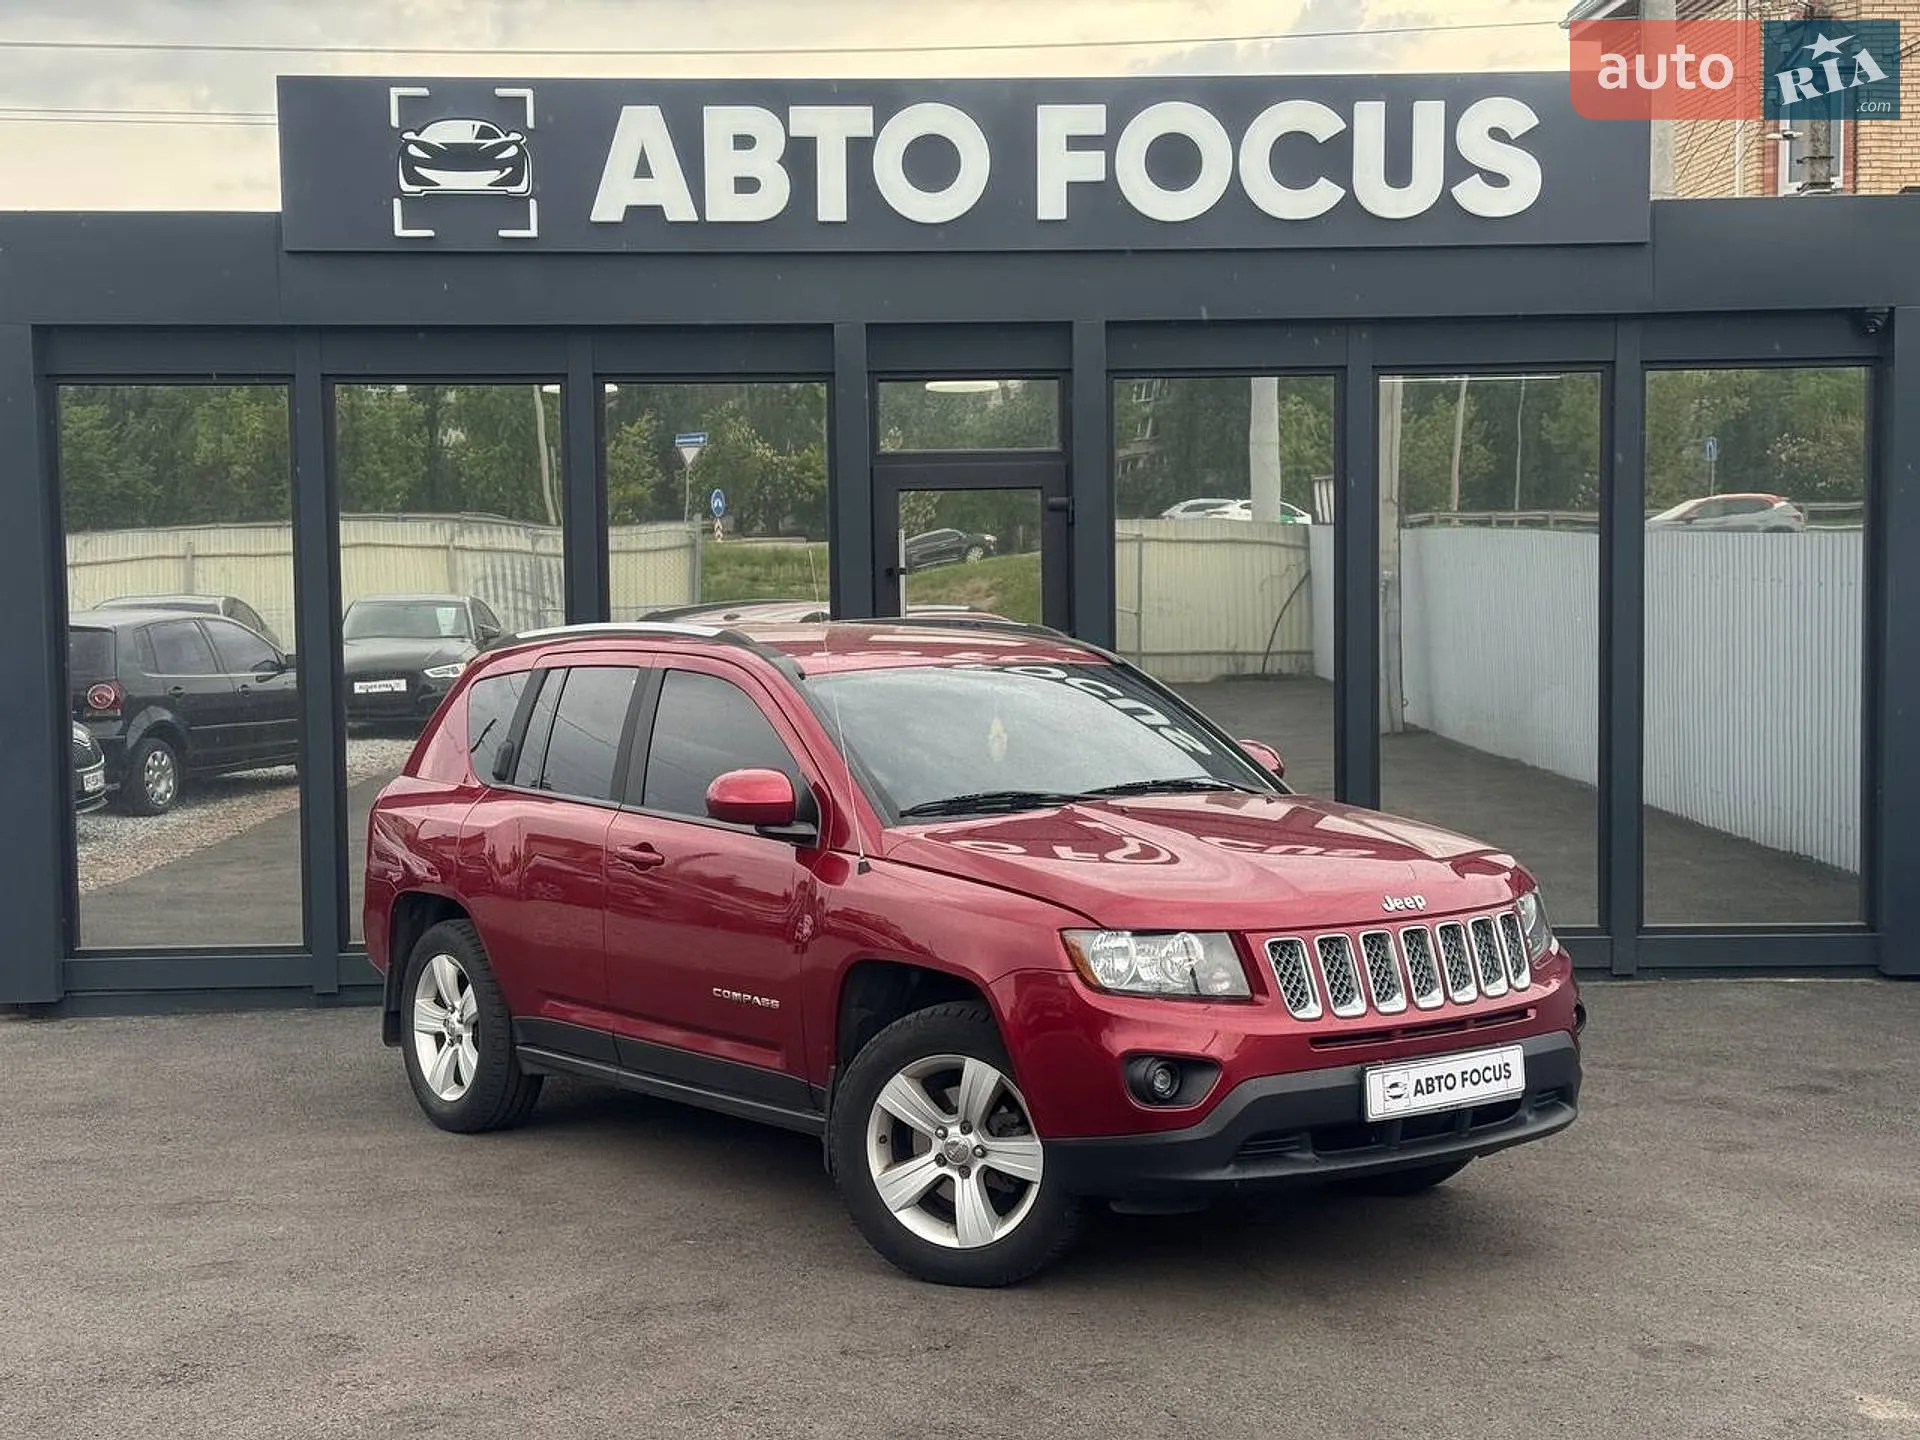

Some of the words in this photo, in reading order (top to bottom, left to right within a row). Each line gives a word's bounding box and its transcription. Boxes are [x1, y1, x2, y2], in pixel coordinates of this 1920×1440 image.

[590, 102, 991, 224] АВТО
[1037, 97, 1542, 221] FOCUS
[1381, 895, 1427, 912] Jeep
[712, 987, 780, 1009] COMPASS
[1413, 1073, 1456, 1097] АВТО
[1461, 1063, 1512, 1088] FOCUS
